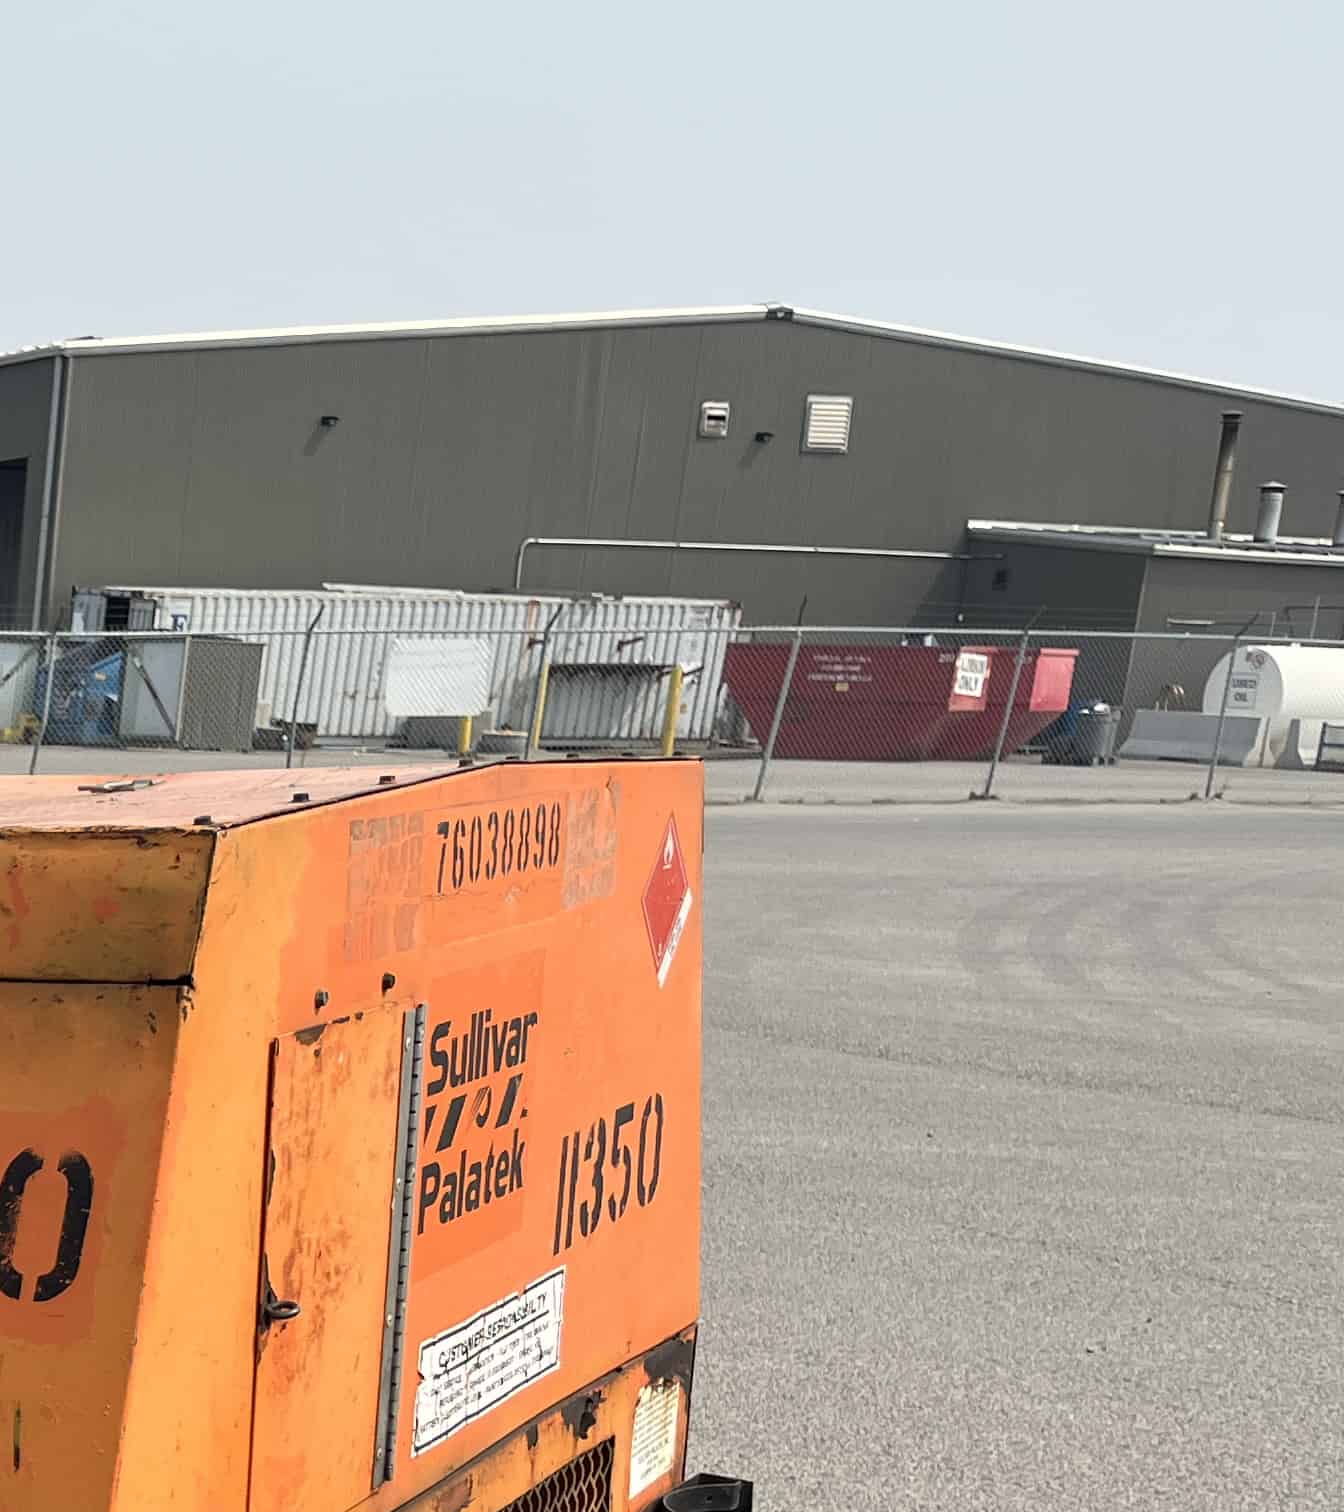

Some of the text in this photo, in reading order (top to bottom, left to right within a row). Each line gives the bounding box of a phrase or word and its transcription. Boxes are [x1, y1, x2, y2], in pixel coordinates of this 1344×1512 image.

[436, 802, 561, 895] 76038898
[416, 1127, 526, 1236] Palatek
[553, 1092, 664, 1257] 11350
